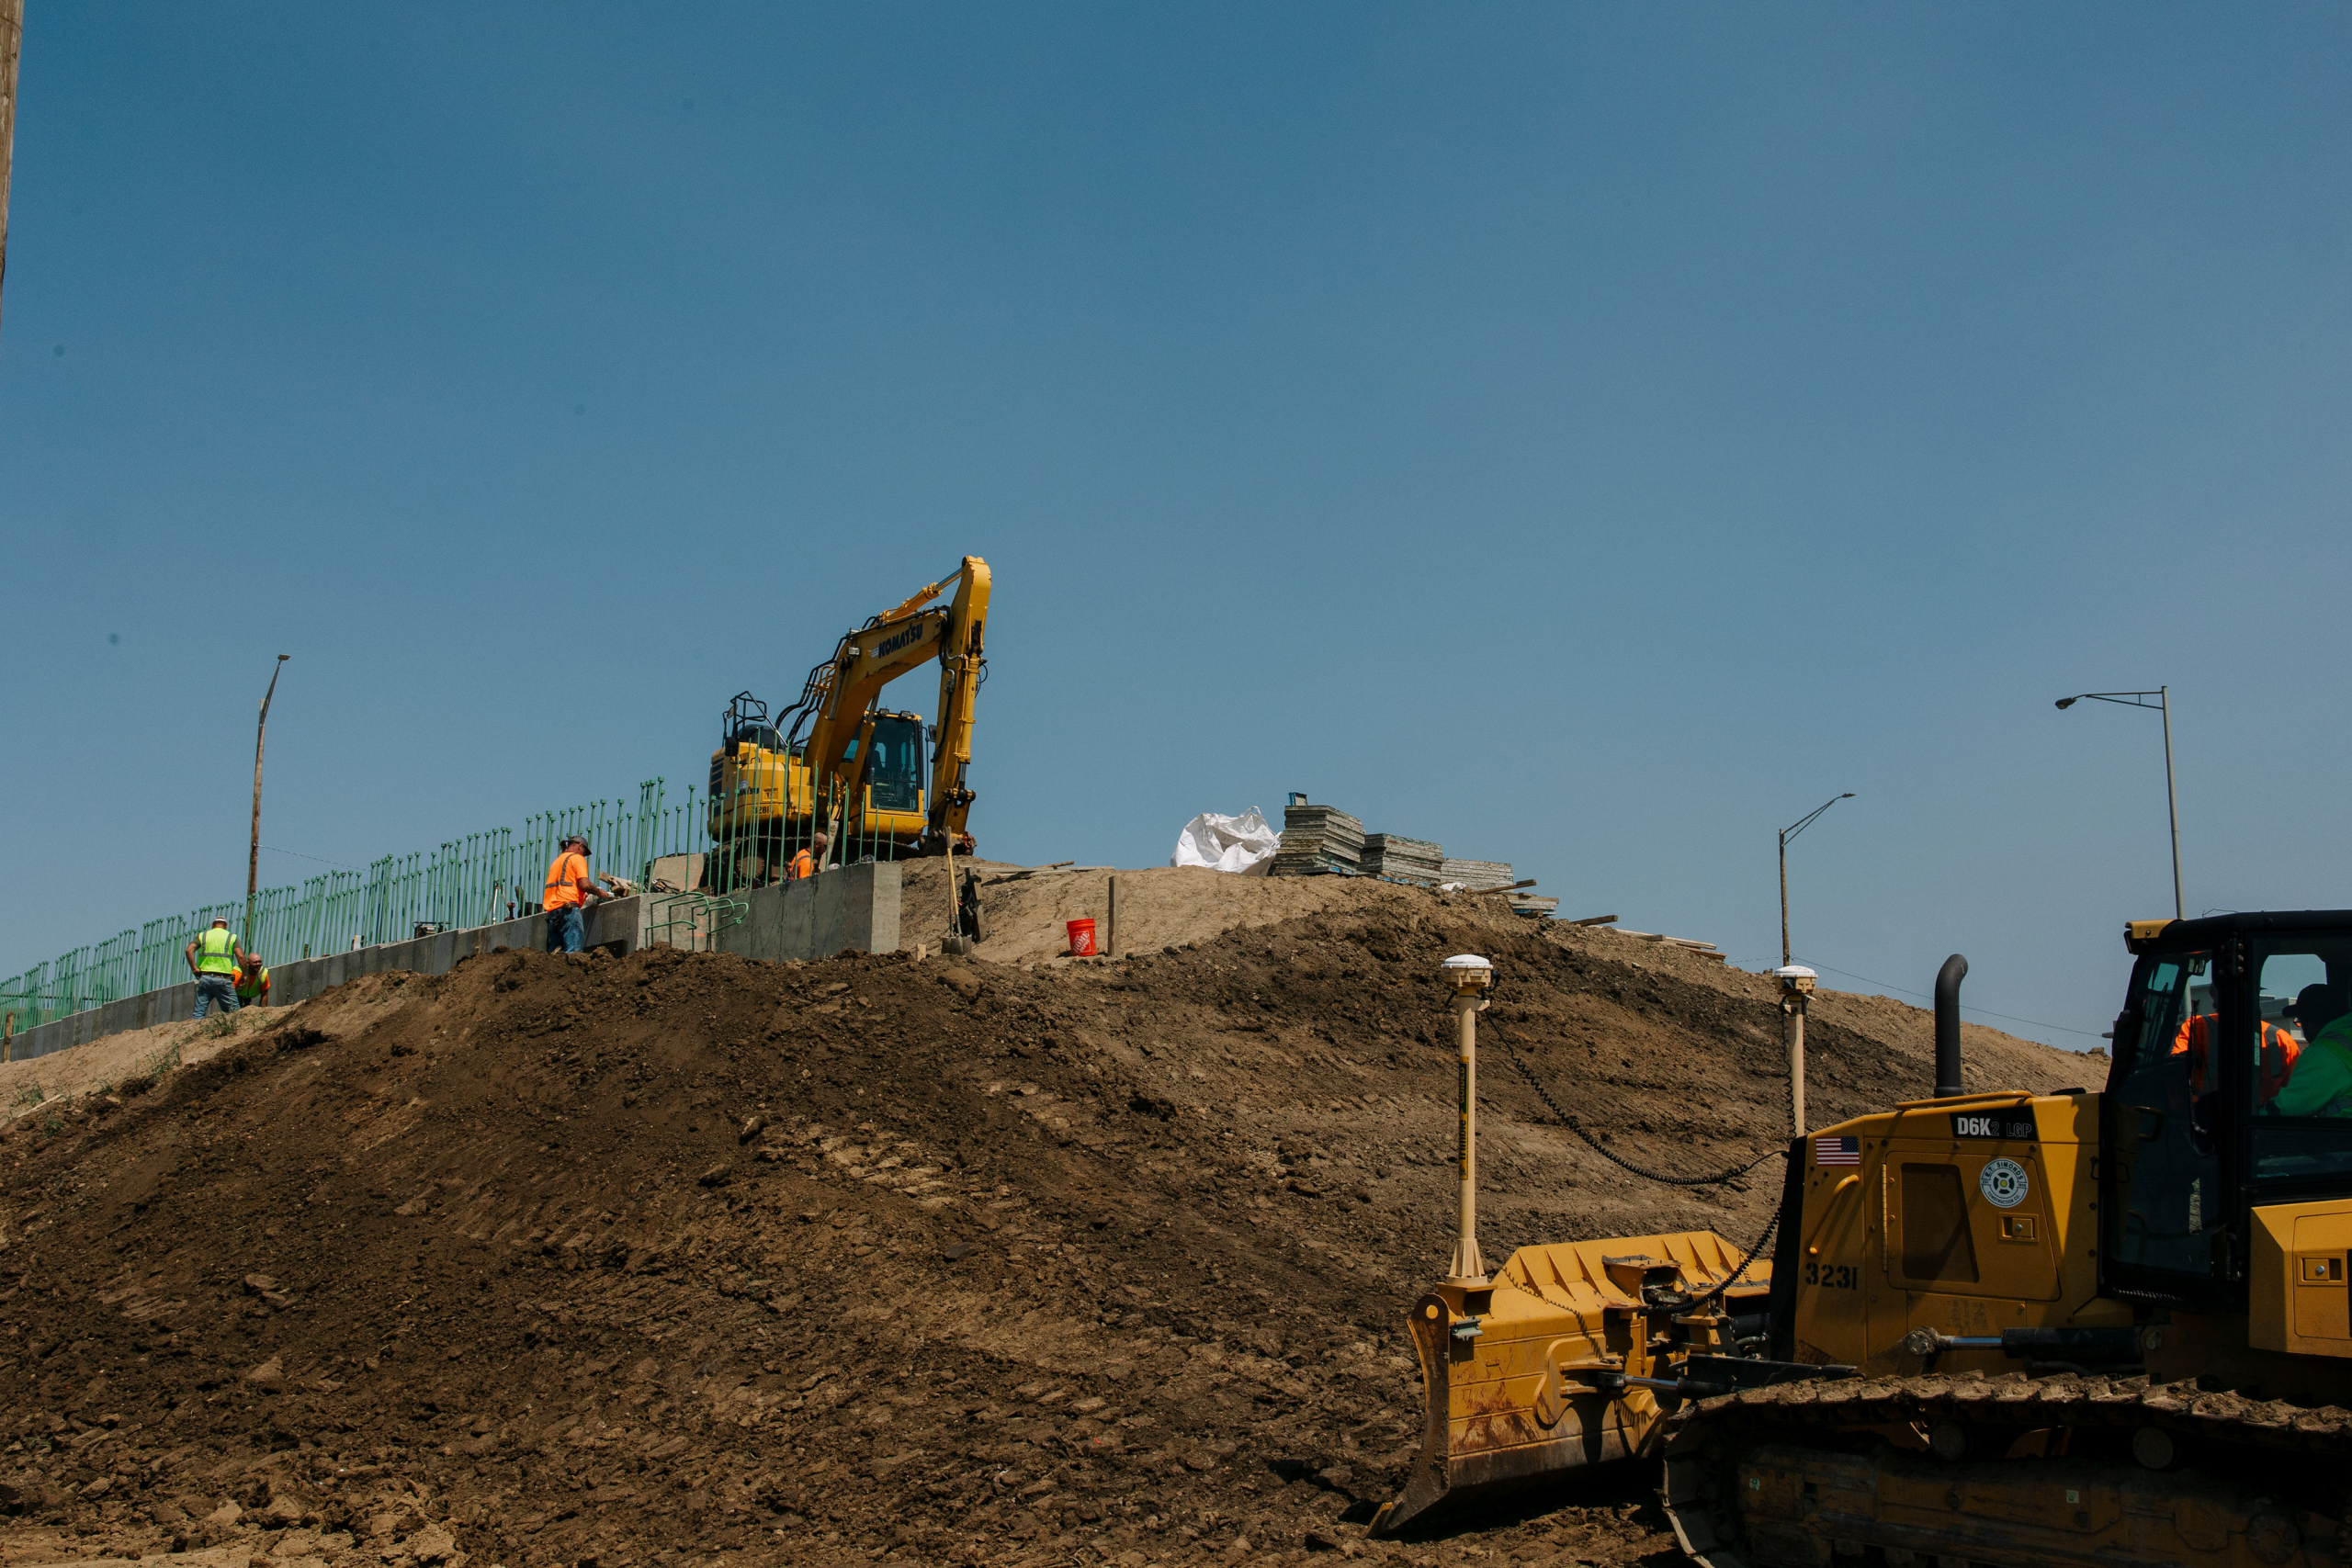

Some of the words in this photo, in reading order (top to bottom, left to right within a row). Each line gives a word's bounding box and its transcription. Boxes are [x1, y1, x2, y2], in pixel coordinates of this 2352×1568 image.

[878, 622, 923, 659] KOMATSU
[2006, 1122, 2032, 1137] LGP
[1996, 1161, 2024, 1179] SIMONDS
[1805, 1262, 1857, 1290] 3231
